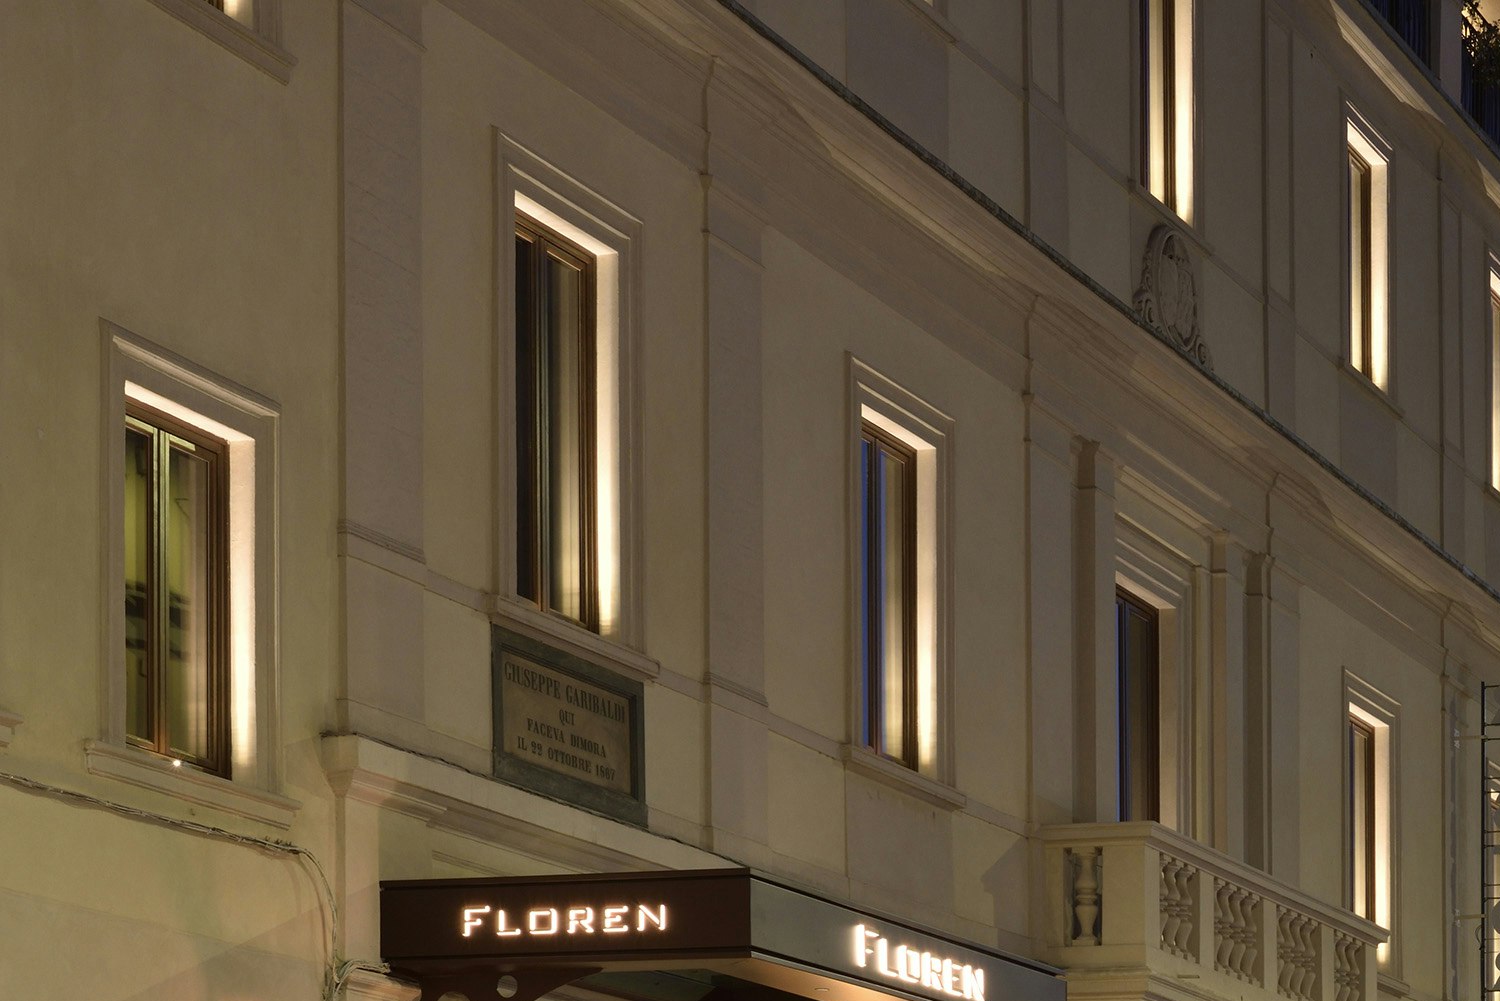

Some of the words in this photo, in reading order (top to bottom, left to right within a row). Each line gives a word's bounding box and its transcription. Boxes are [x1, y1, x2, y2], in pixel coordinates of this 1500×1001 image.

[504, 661, 561, 700] GIUSEPPE
[565, 684, 625, 724] GARIBALDI
[558, 709, 575, 727] QUI
[517, 736, 528, 751] IL
[531, 741, 543, 757] 22
[547, 747, 592, 774] OTTOBRE
[526, 718, 566, 744] FACEVA
[570, 734, 607, 759] DIMORA
[461, 903, 667, 937] FLOREN
